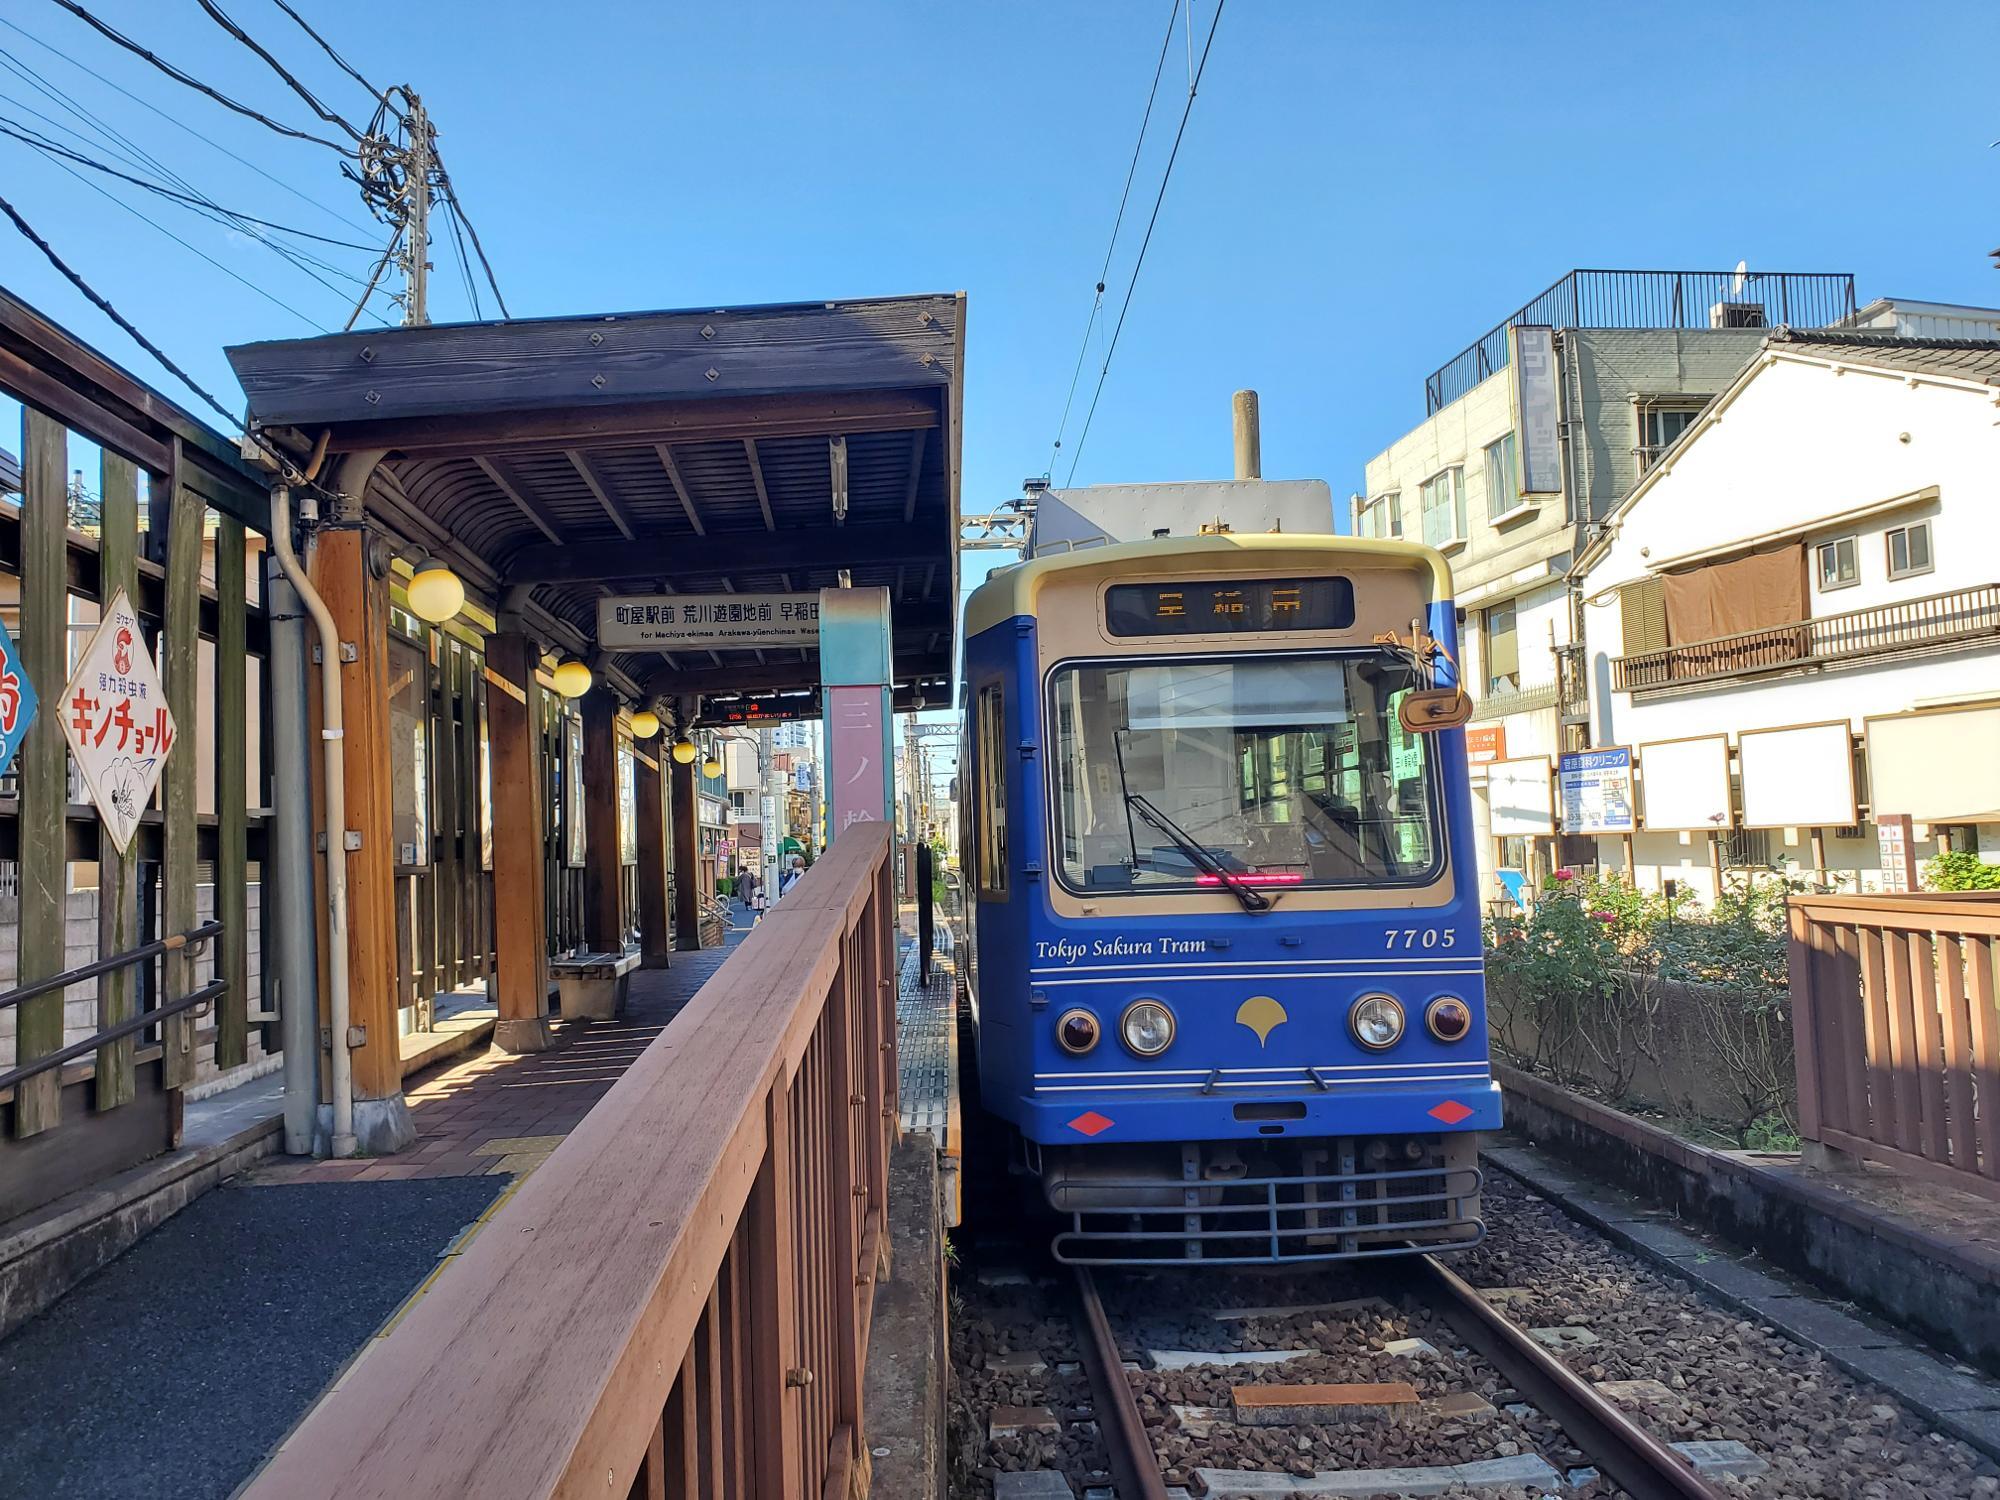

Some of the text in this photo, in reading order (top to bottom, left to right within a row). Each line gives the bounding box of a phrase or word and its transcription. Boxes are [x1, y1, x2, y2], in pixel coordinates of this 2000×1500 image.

[116, 612, 134, 629] ヨクキク
[616, 602, 819, 625] 町屋駅前 荒川遊園地前 早稲田
[640, 631, 652, 639] for
[99, 672, 147, 700] 強力殺虫液
[72, 687, 173, 755] キンチョール
[1385, 928, 1455, 949] 7705
[1036, 936, 1207, 965] Tokyo Sakura Tram
